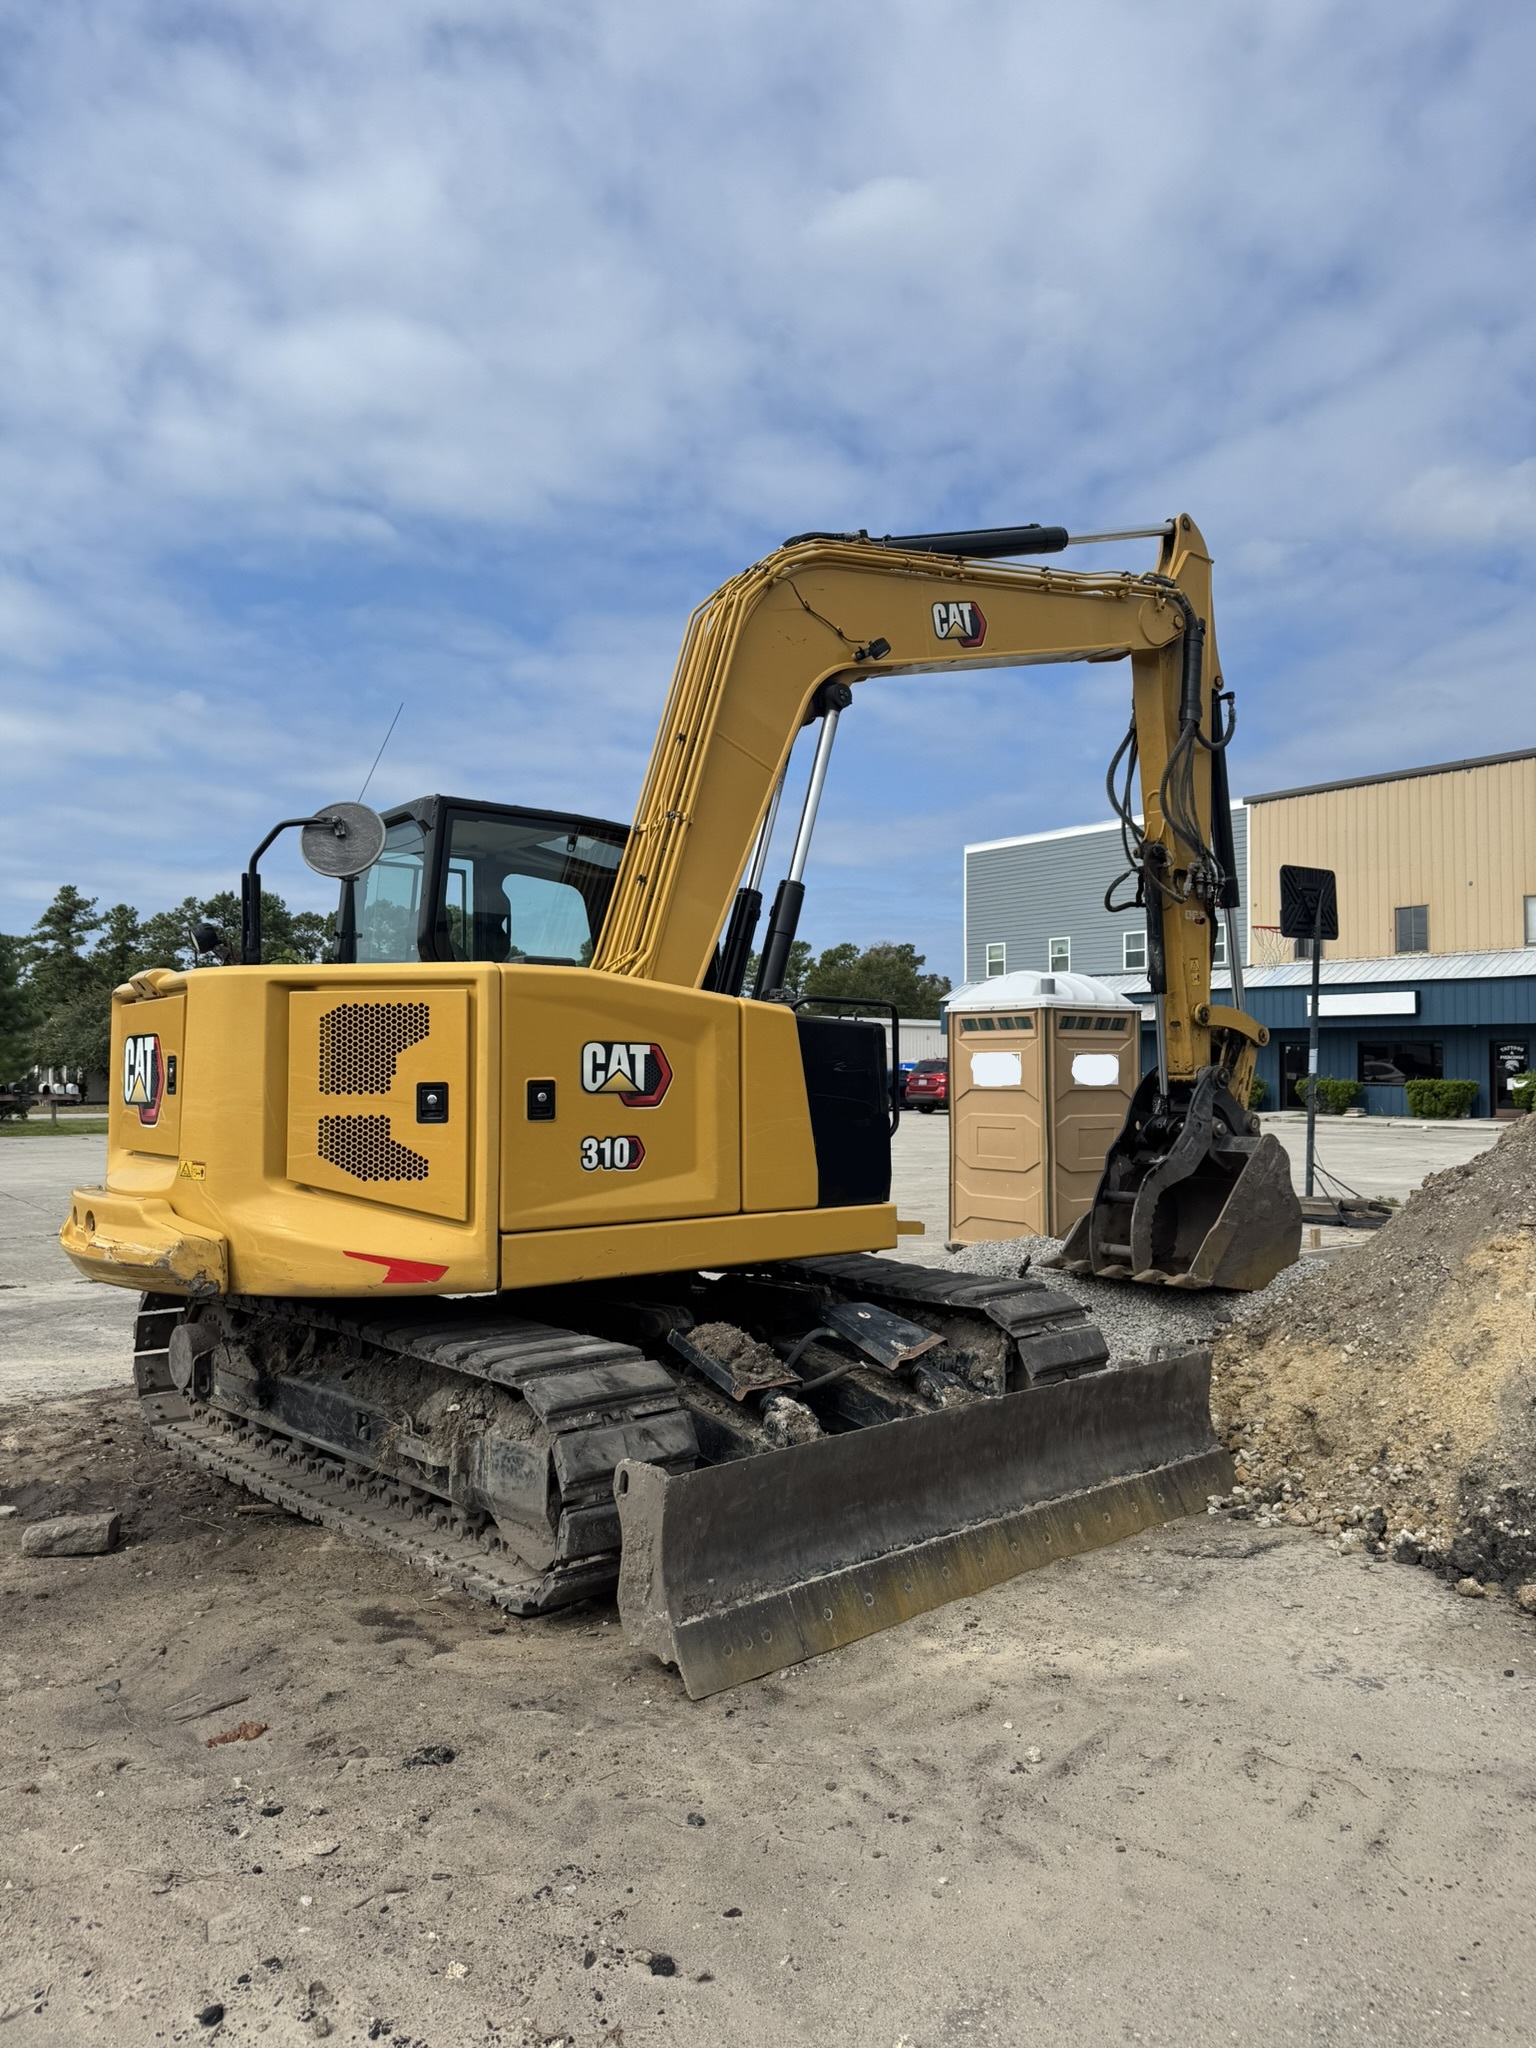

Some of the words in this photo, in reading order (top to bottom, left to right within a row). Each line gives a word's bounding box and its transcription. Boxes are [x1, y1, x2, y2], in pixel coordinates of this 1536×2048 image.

[932, 602, 973, 639] CAT
[124, 1036, 156, 1103] CAT
[582, 1041, 651, 1092] CAT
[582, 1136, 630, 1169] 310
